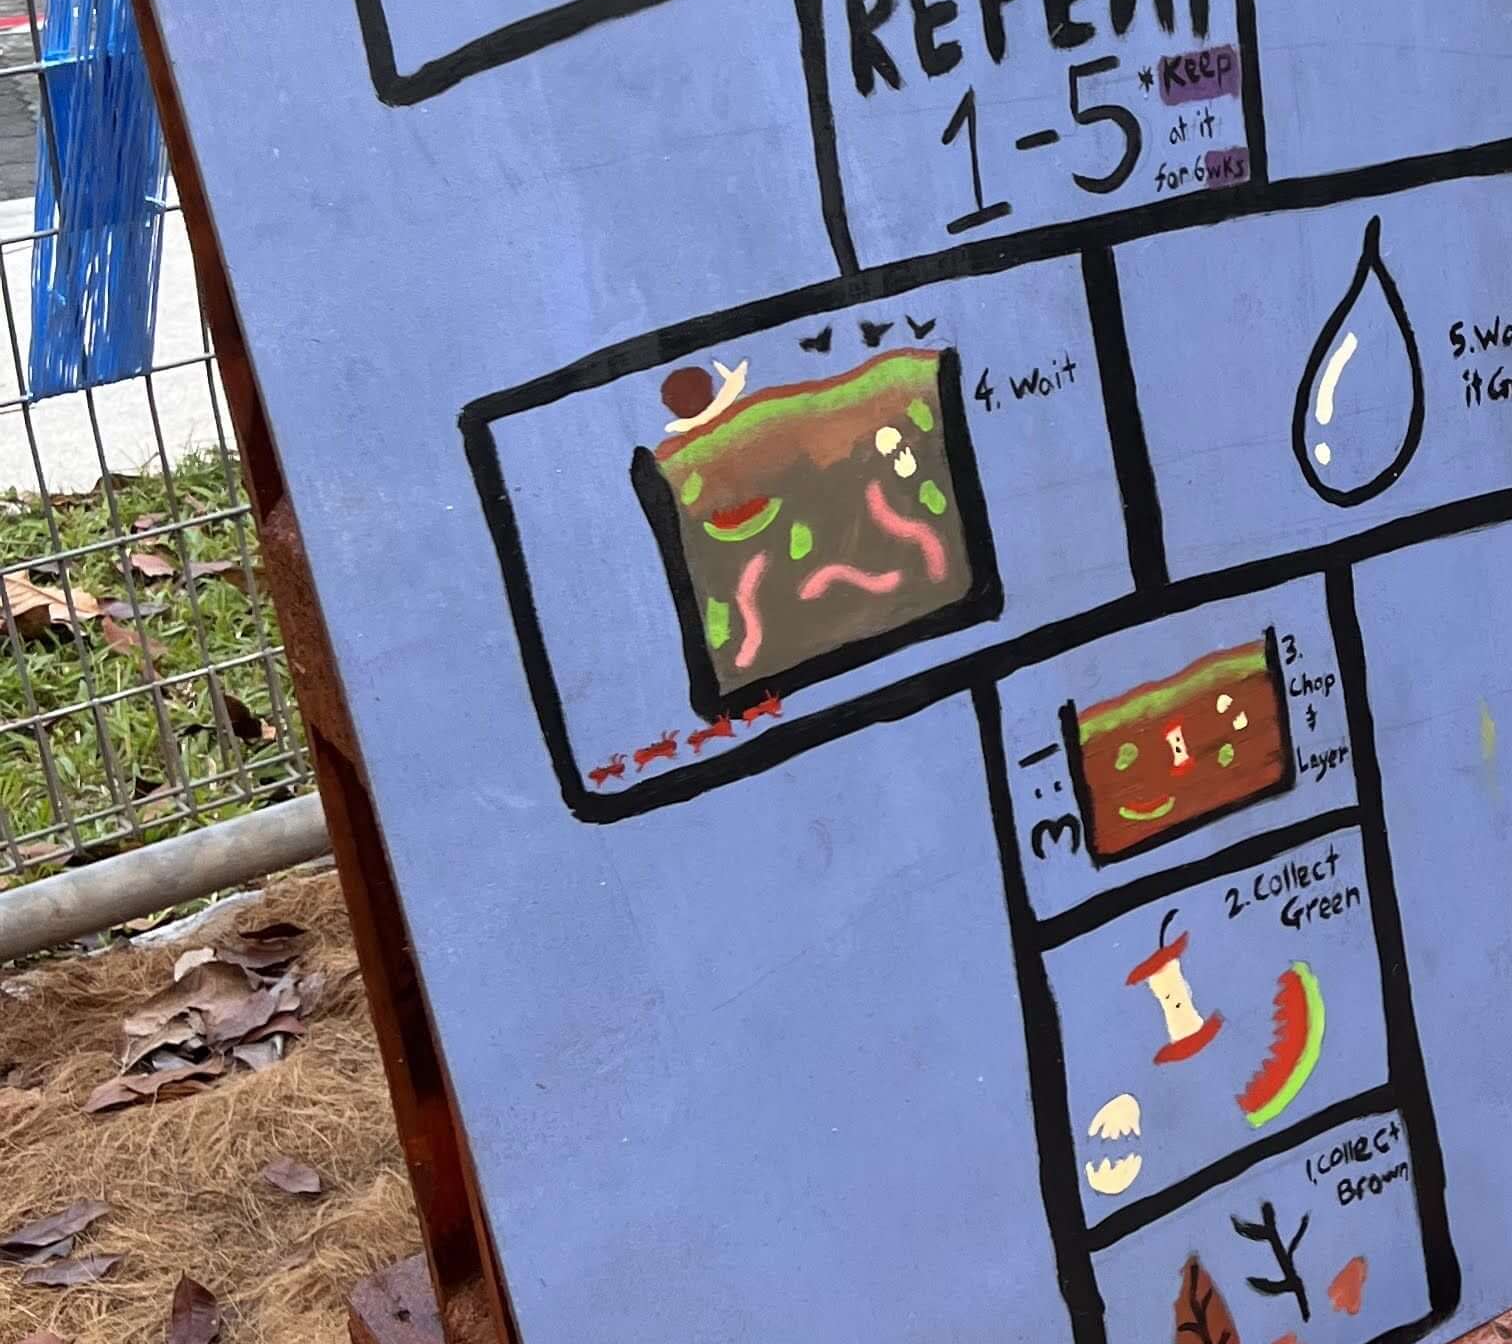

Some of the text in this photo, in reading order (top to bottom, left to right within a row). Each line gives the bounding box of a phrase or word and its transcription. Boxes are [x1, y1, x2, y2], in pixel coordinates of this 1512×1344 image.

[1169, 106, 1215, 144] at it
[1154, 161, 1188, 192] for
[1009, 350, 1077, 399] Wait
[1462, 369, 1483, 408] it
[1290, 672, 1336, 698] Chop
[1297, 744, 1350, 782] Layer
[1280, 885, 1361, 930] Green
[1337, 1160, 1410, 1206] Brown
